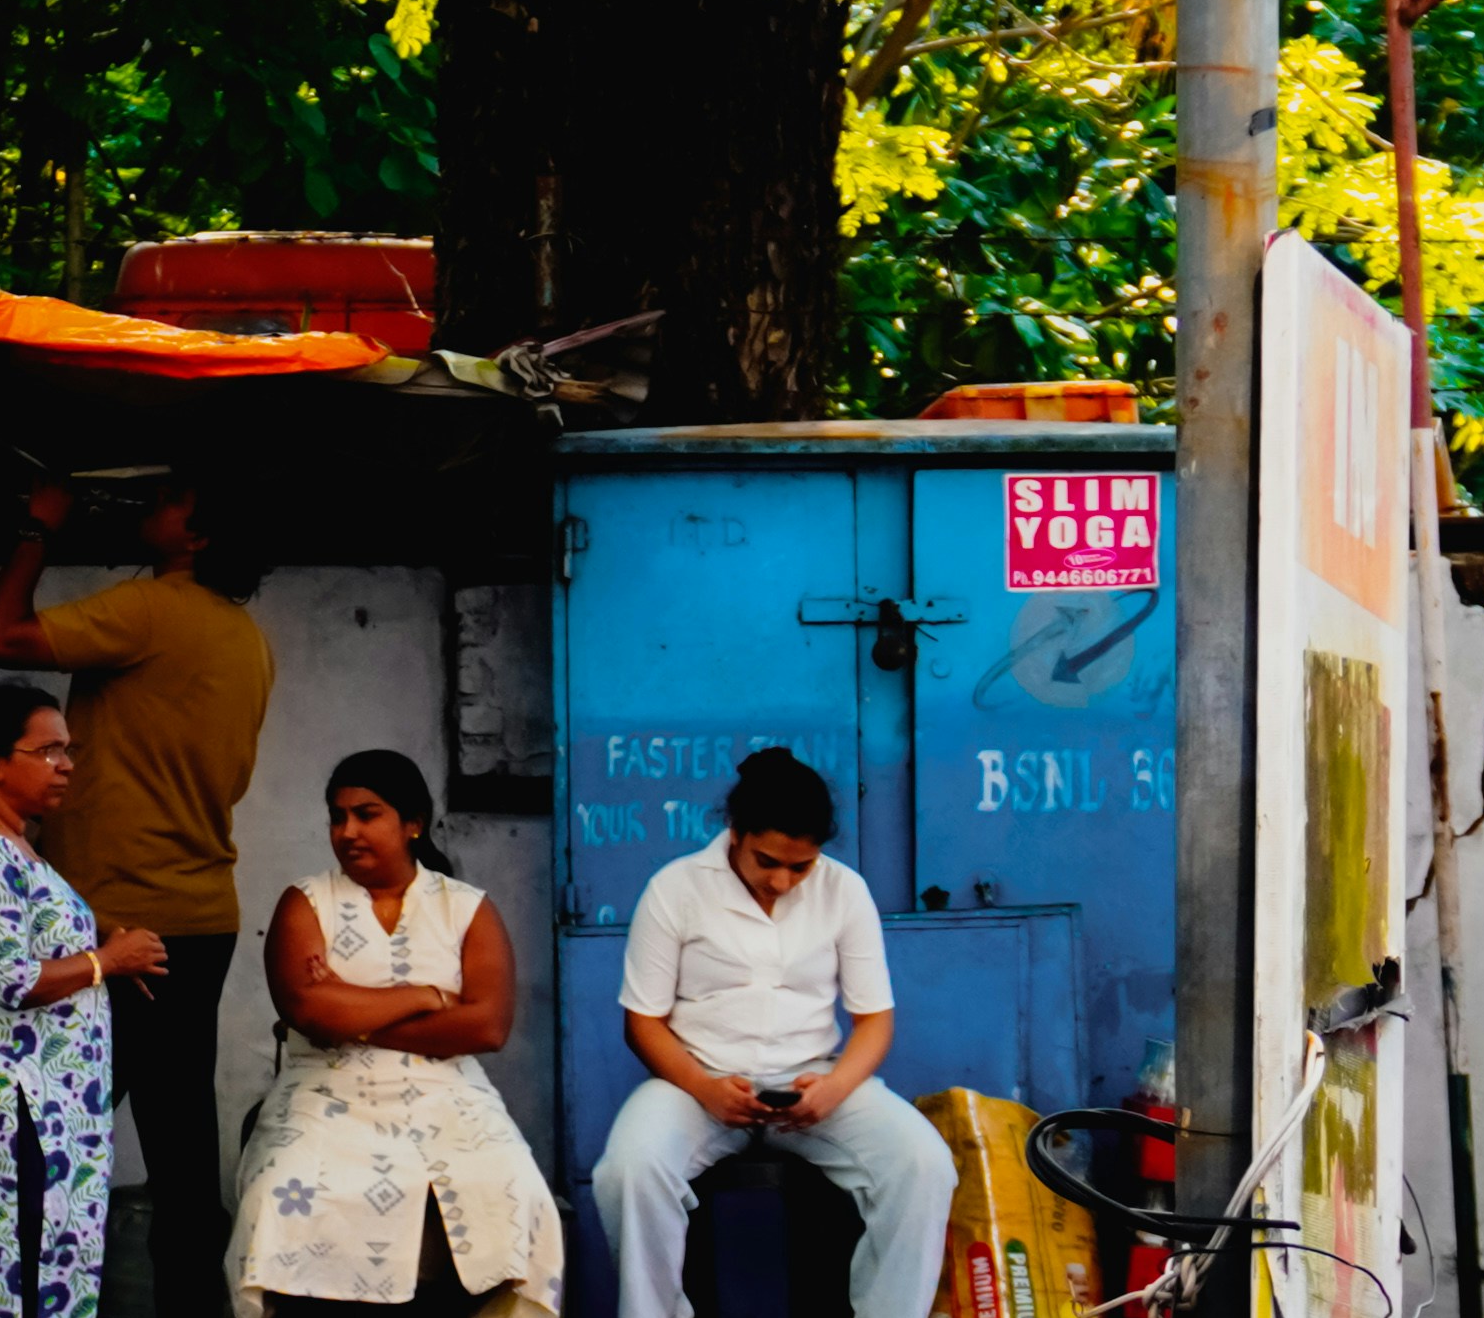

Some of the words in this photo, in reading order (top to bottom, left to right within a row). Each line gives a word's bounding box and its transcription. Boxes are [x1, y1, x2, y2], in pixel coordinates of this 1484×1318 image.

[1013, 478, 1150, 513] SLIM
[1014, 515, 1151, 550] YOGA
[607, 735, 733, 780] FASTER
[976, 749, 1106, 813] BSNL
